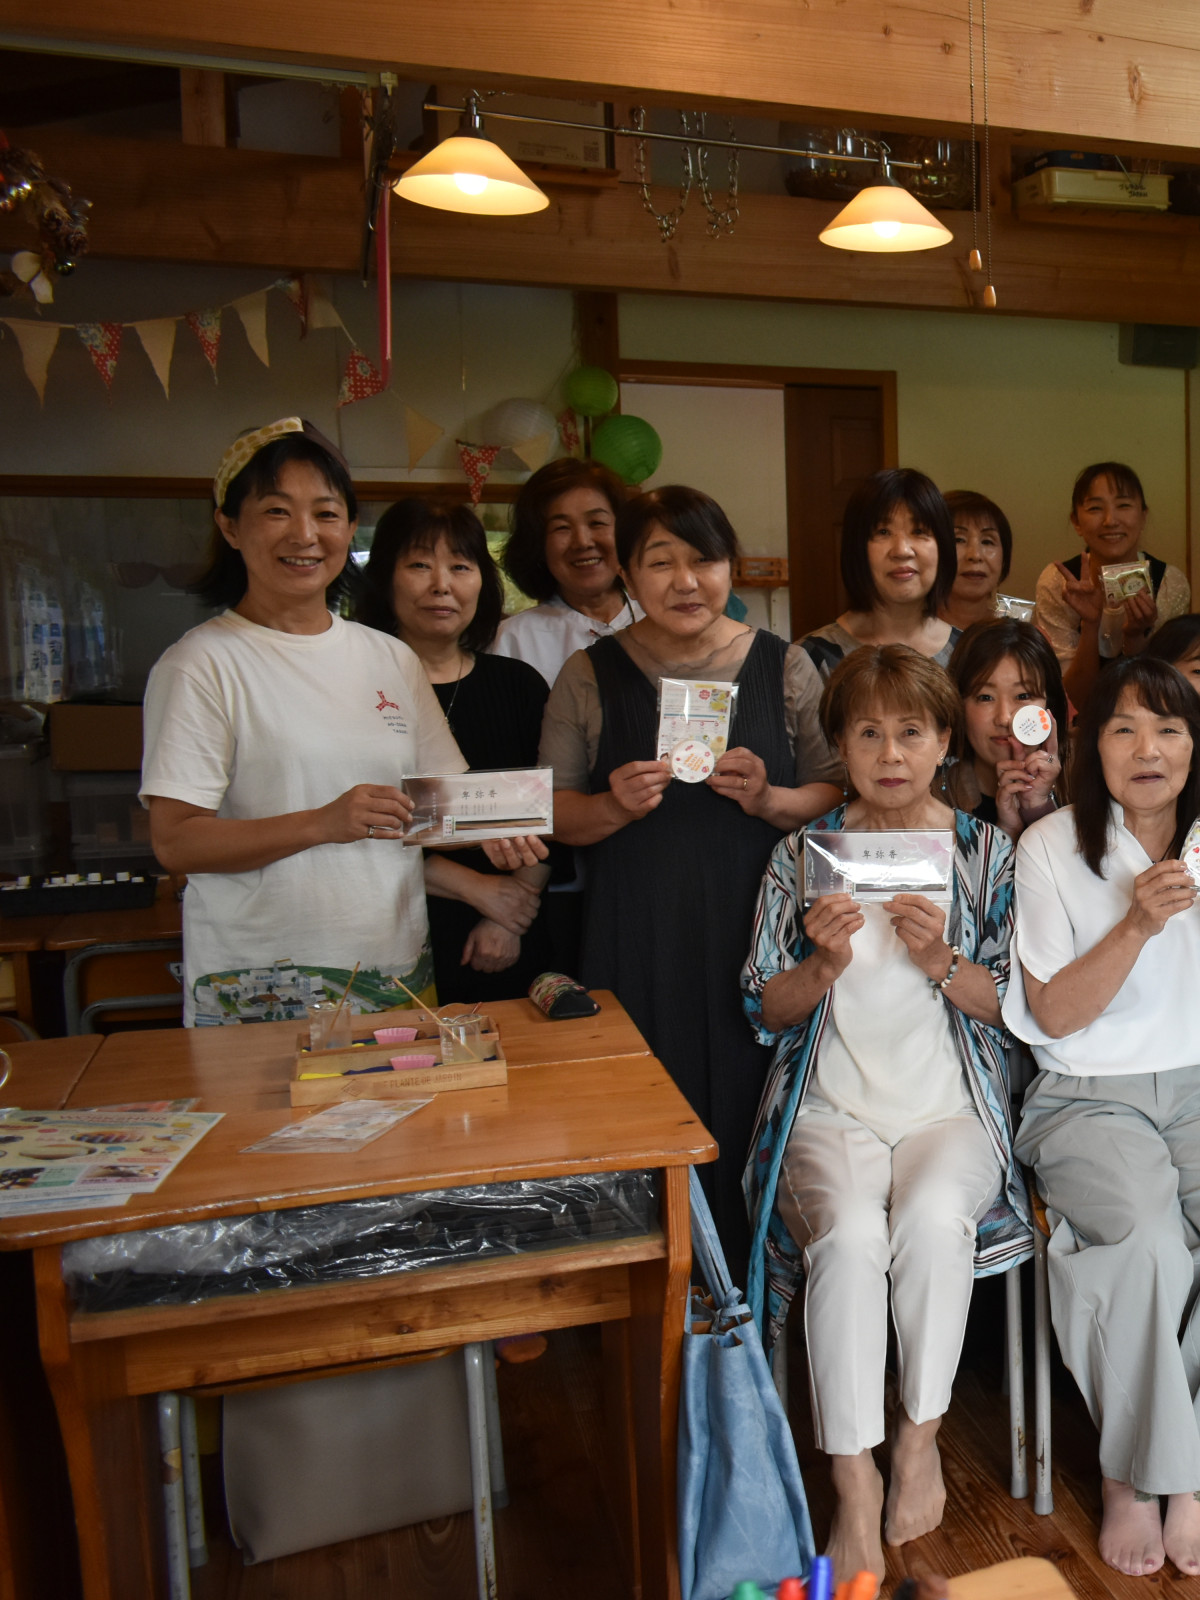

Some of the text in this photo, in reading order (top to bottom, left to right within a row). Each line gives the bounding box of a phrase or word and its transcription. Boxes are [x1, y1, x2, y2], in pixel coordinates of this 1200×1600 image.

[862, 849, 898, 859] 卑弥香
[390, 1077, 420, 1088] PLANTE
